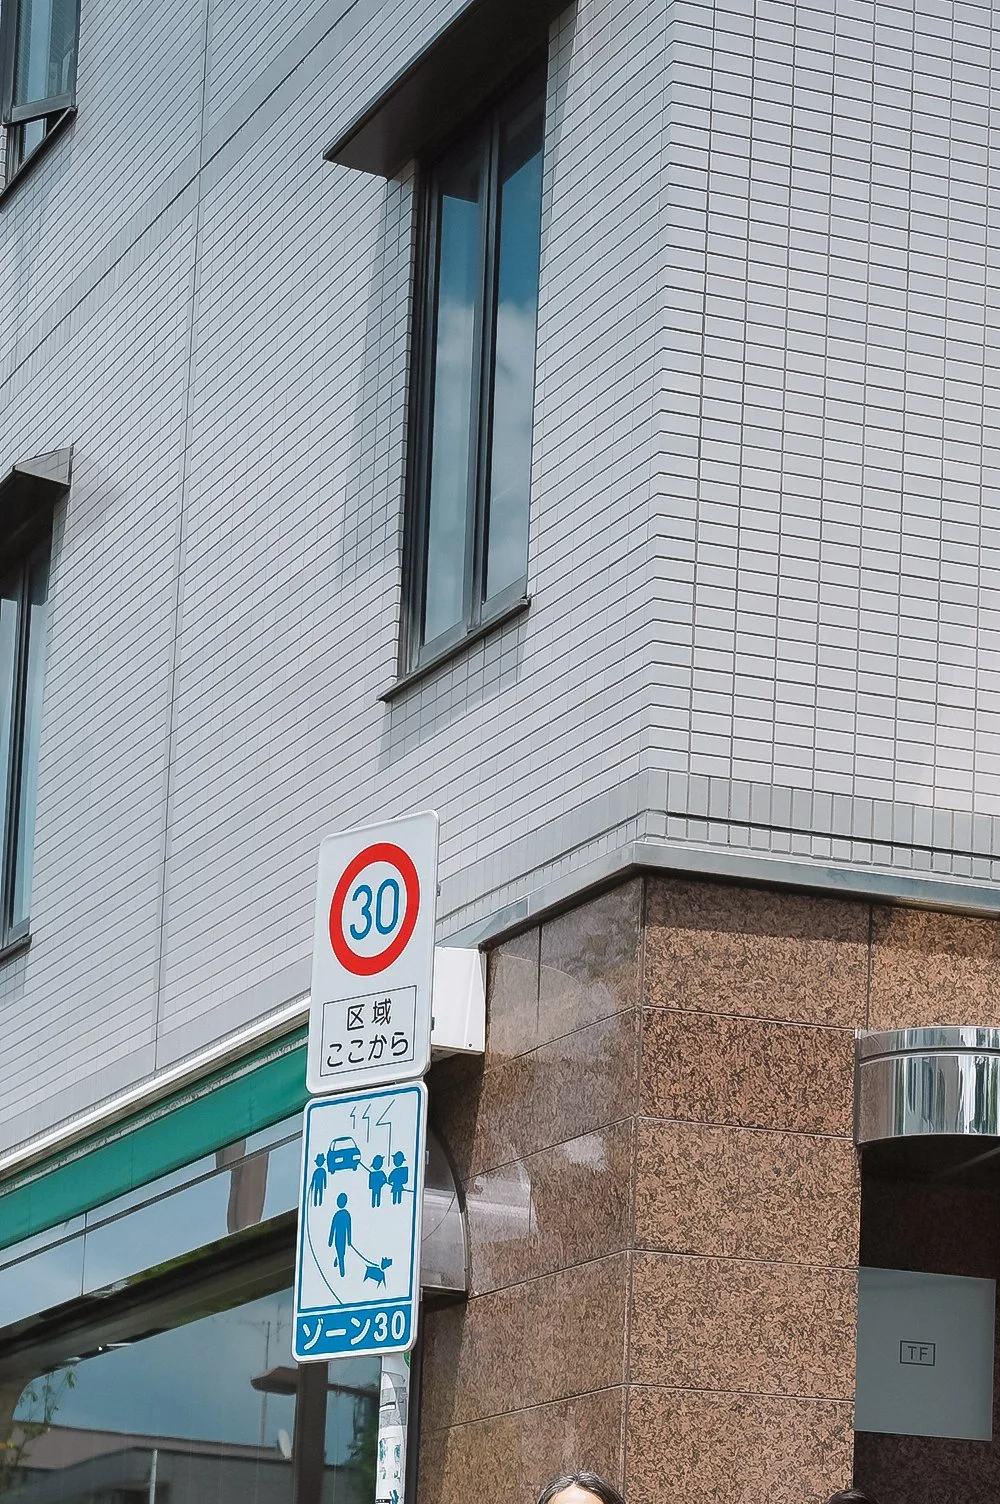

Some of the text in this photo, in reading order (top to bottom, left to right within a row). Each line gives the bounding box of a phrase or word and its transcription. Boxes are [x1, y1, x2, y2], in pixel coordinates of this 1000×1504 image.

[350, 878, 399, 940] 30
[347, 998, 392, 1031] 区域
[327, 1032, 409, 1067] ここから
[302, 1310, 407, 1350] ゾーン30
[907, 1345, 929, 1361] TF
